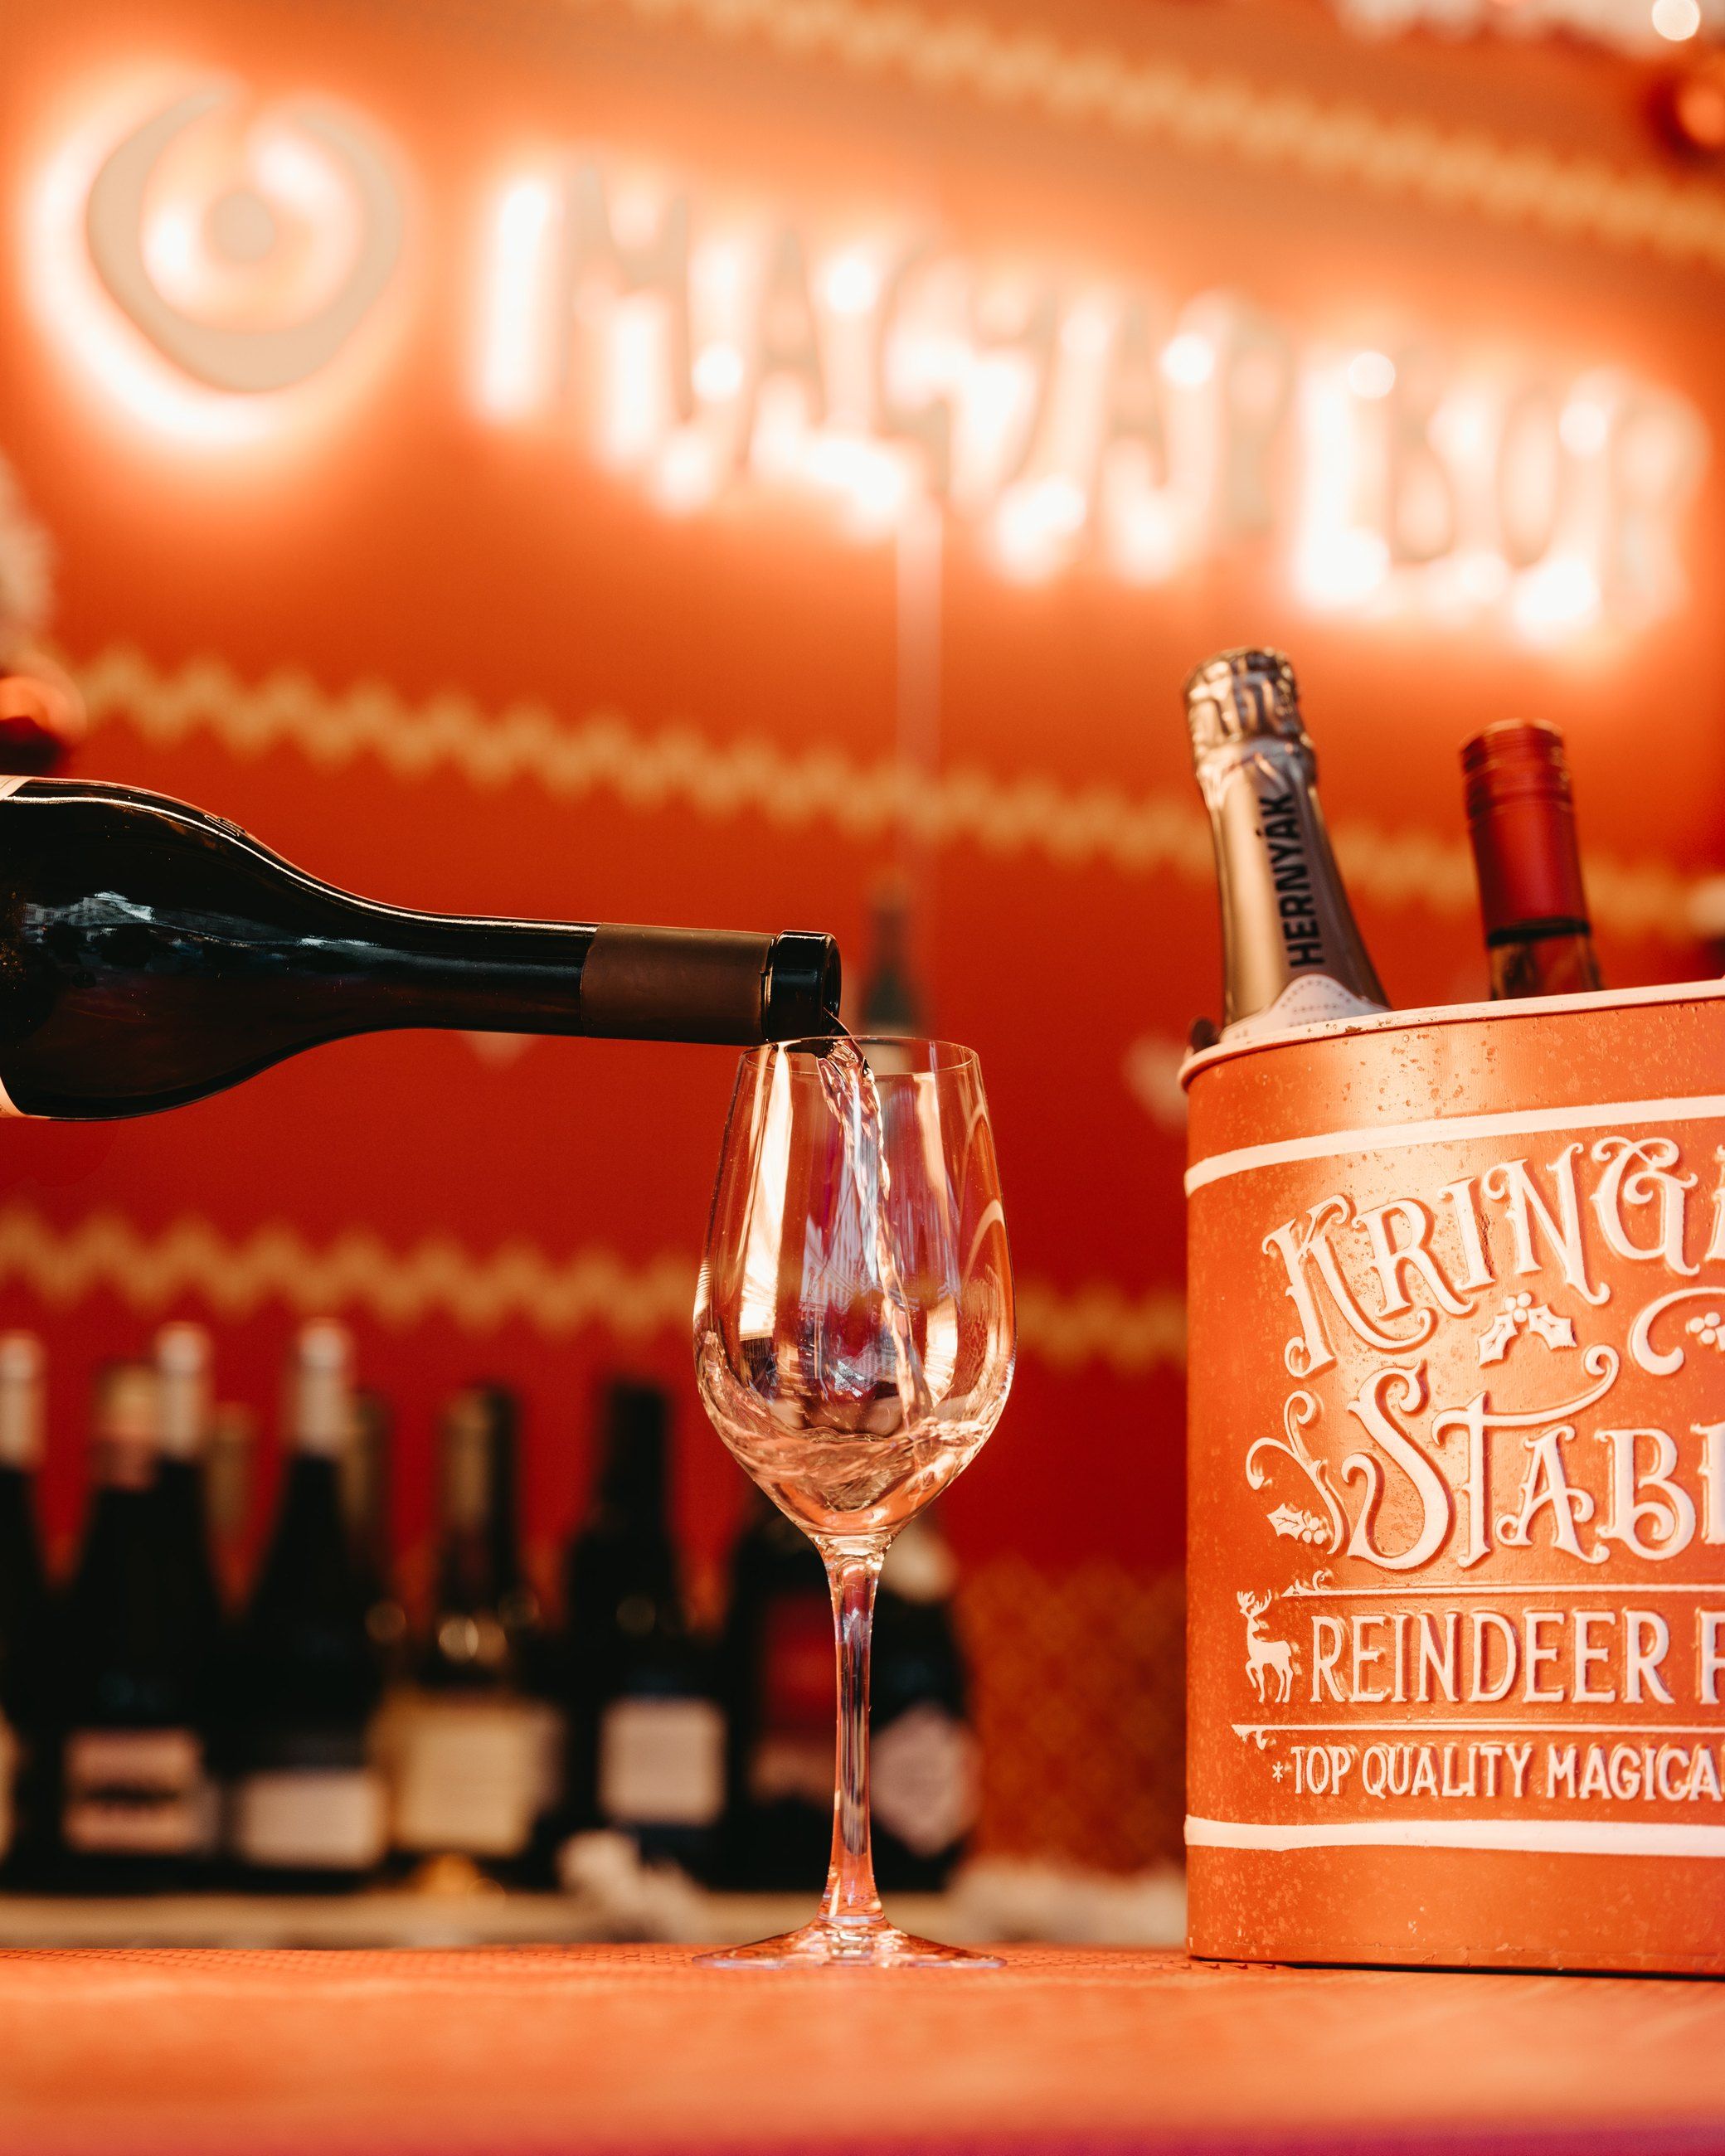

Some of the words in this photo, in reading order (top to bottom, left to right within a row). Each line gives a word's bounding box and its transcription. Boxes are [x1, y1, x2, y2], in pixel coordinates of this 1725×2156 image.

[1256, 794, 1325, 968] HERNYÁK
[1261, 1136, 1725, 1378] KRING
[1310, 1609, 1676, 1704] REINDEER
[1290, 1744, 1352, 1796] TOP
[1362, 1743, 1533, 1799] QUALITY
